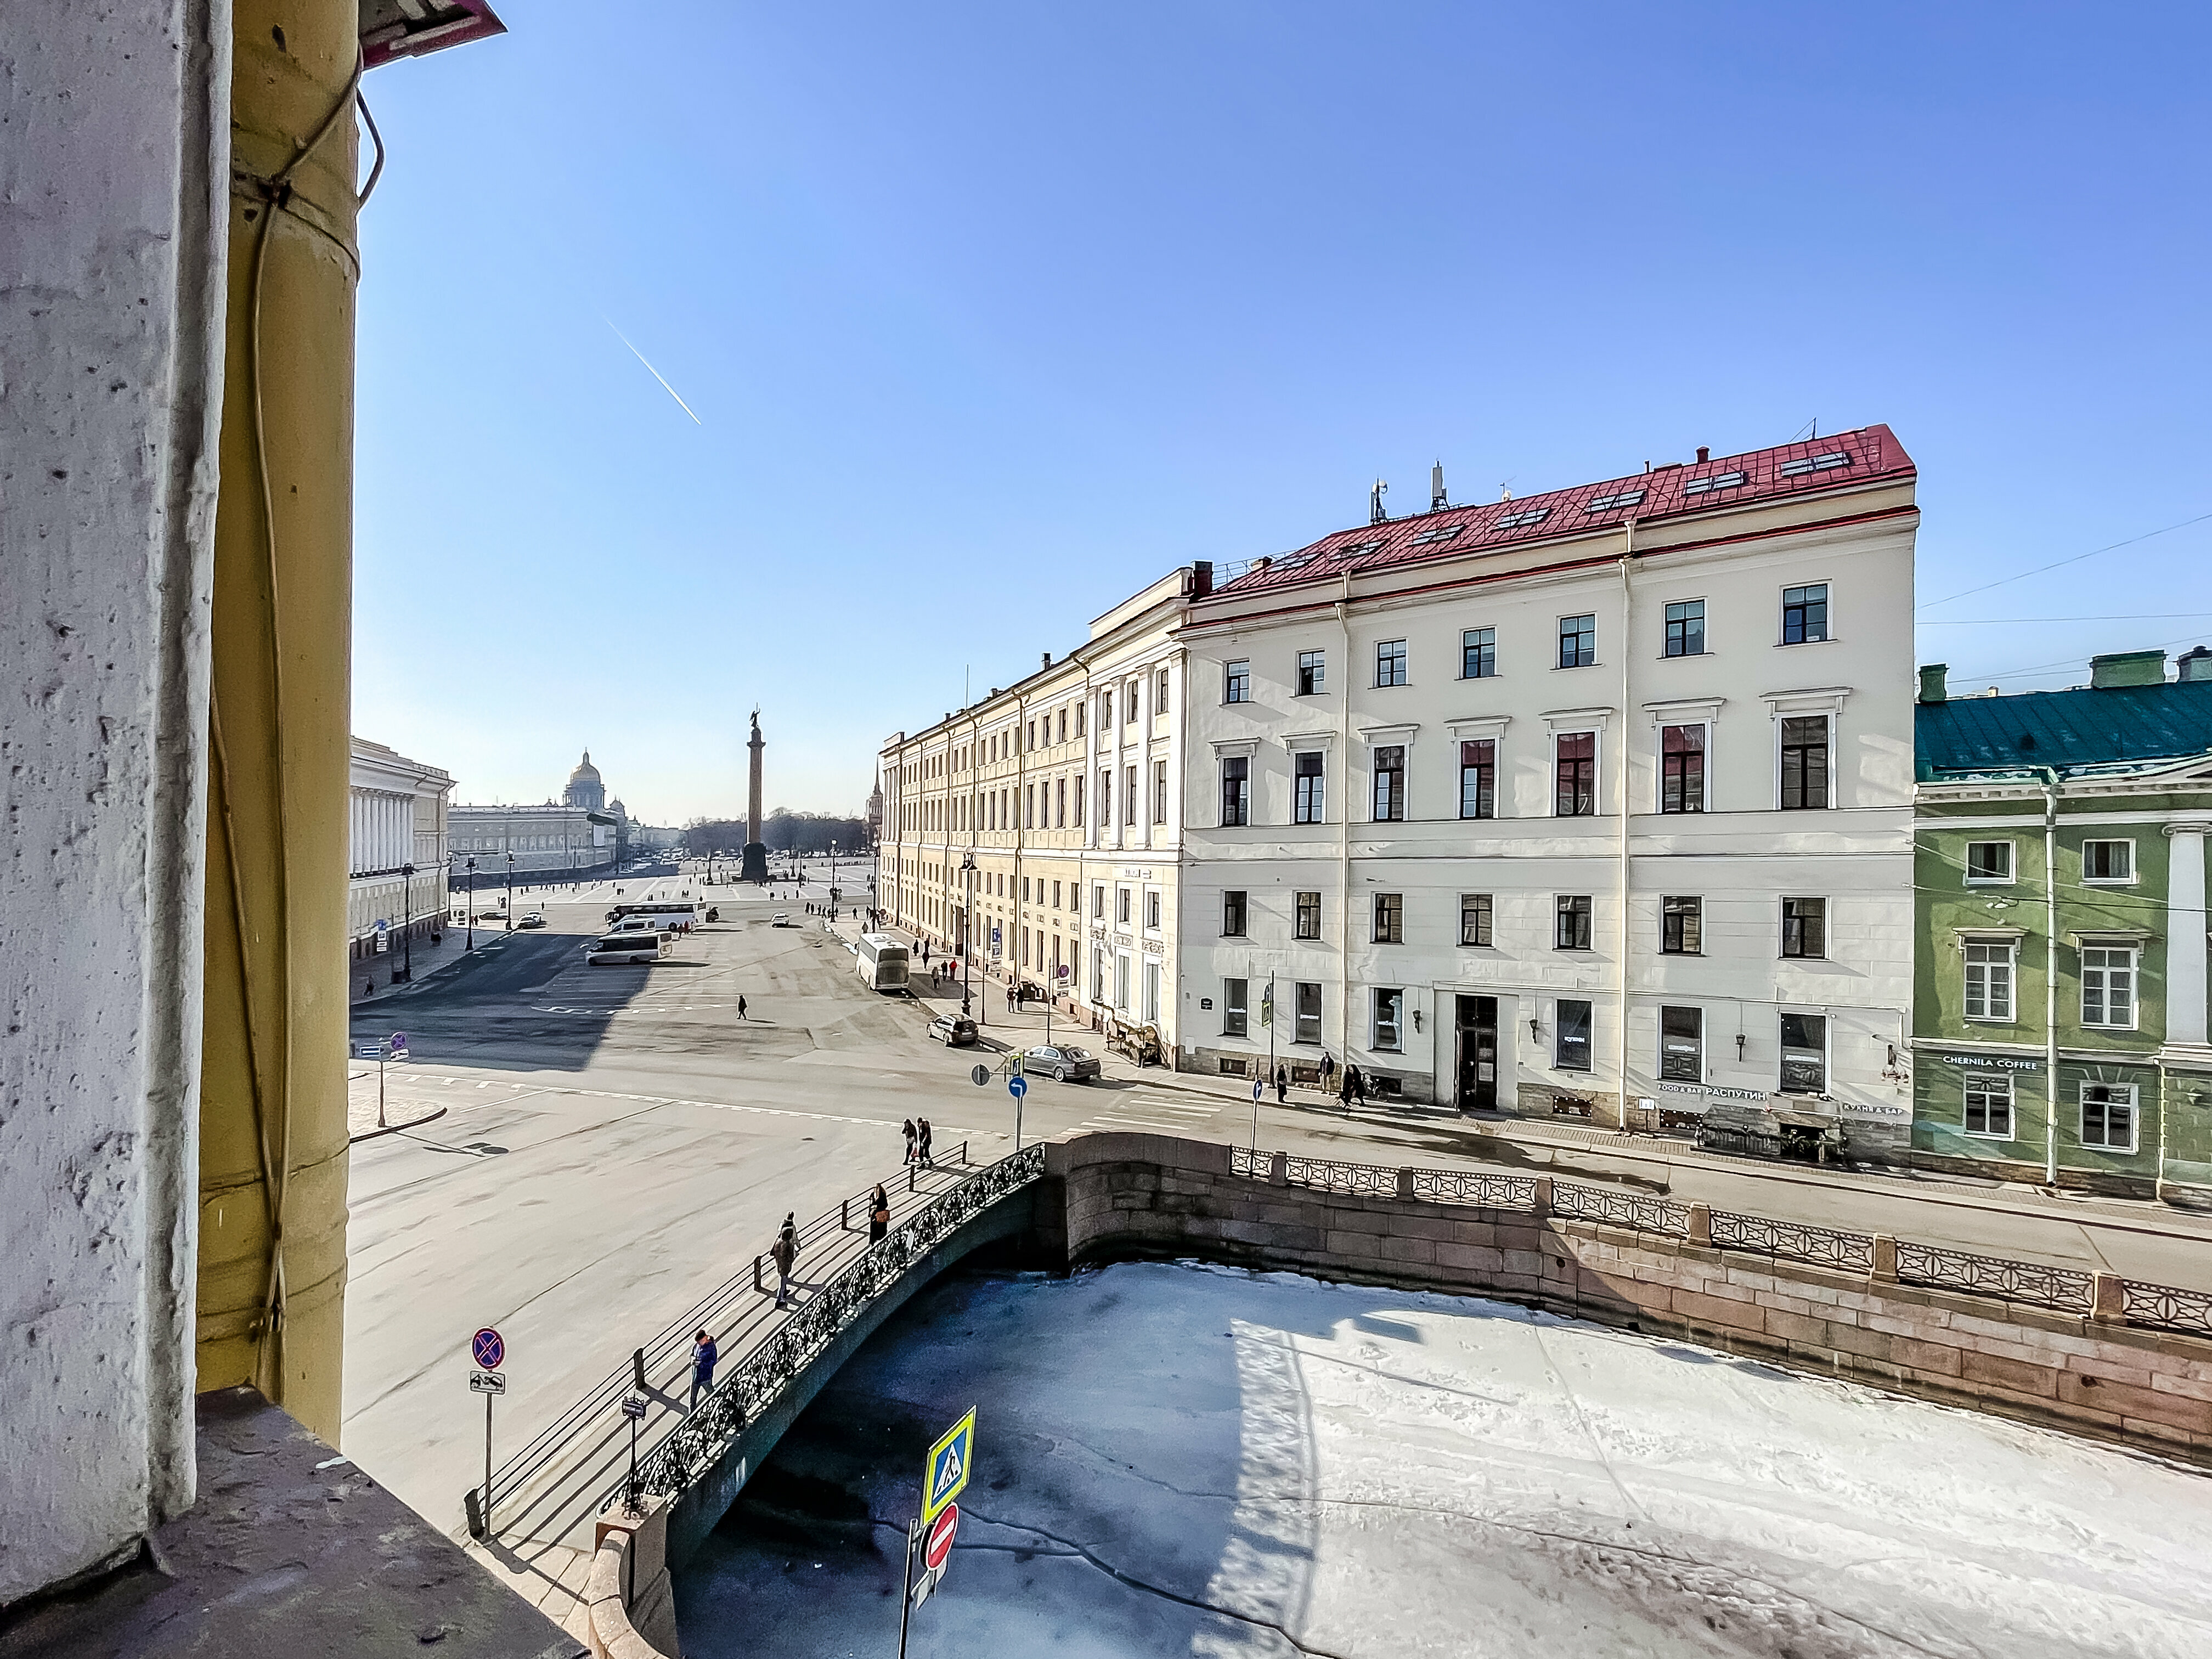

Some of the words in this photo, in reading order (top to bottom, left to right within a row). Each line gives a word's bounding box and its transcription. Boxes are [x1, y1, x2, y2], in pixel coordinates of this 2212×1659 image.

[1943, 1056, 1993, 1066] CHERNILA
[1996, 1060, 2037, 1070] COFFEE
[1706, 1088, 1766, 1101] РАСПУТИН
[1844, 1104, 1874, 1113] КУХНЯ
